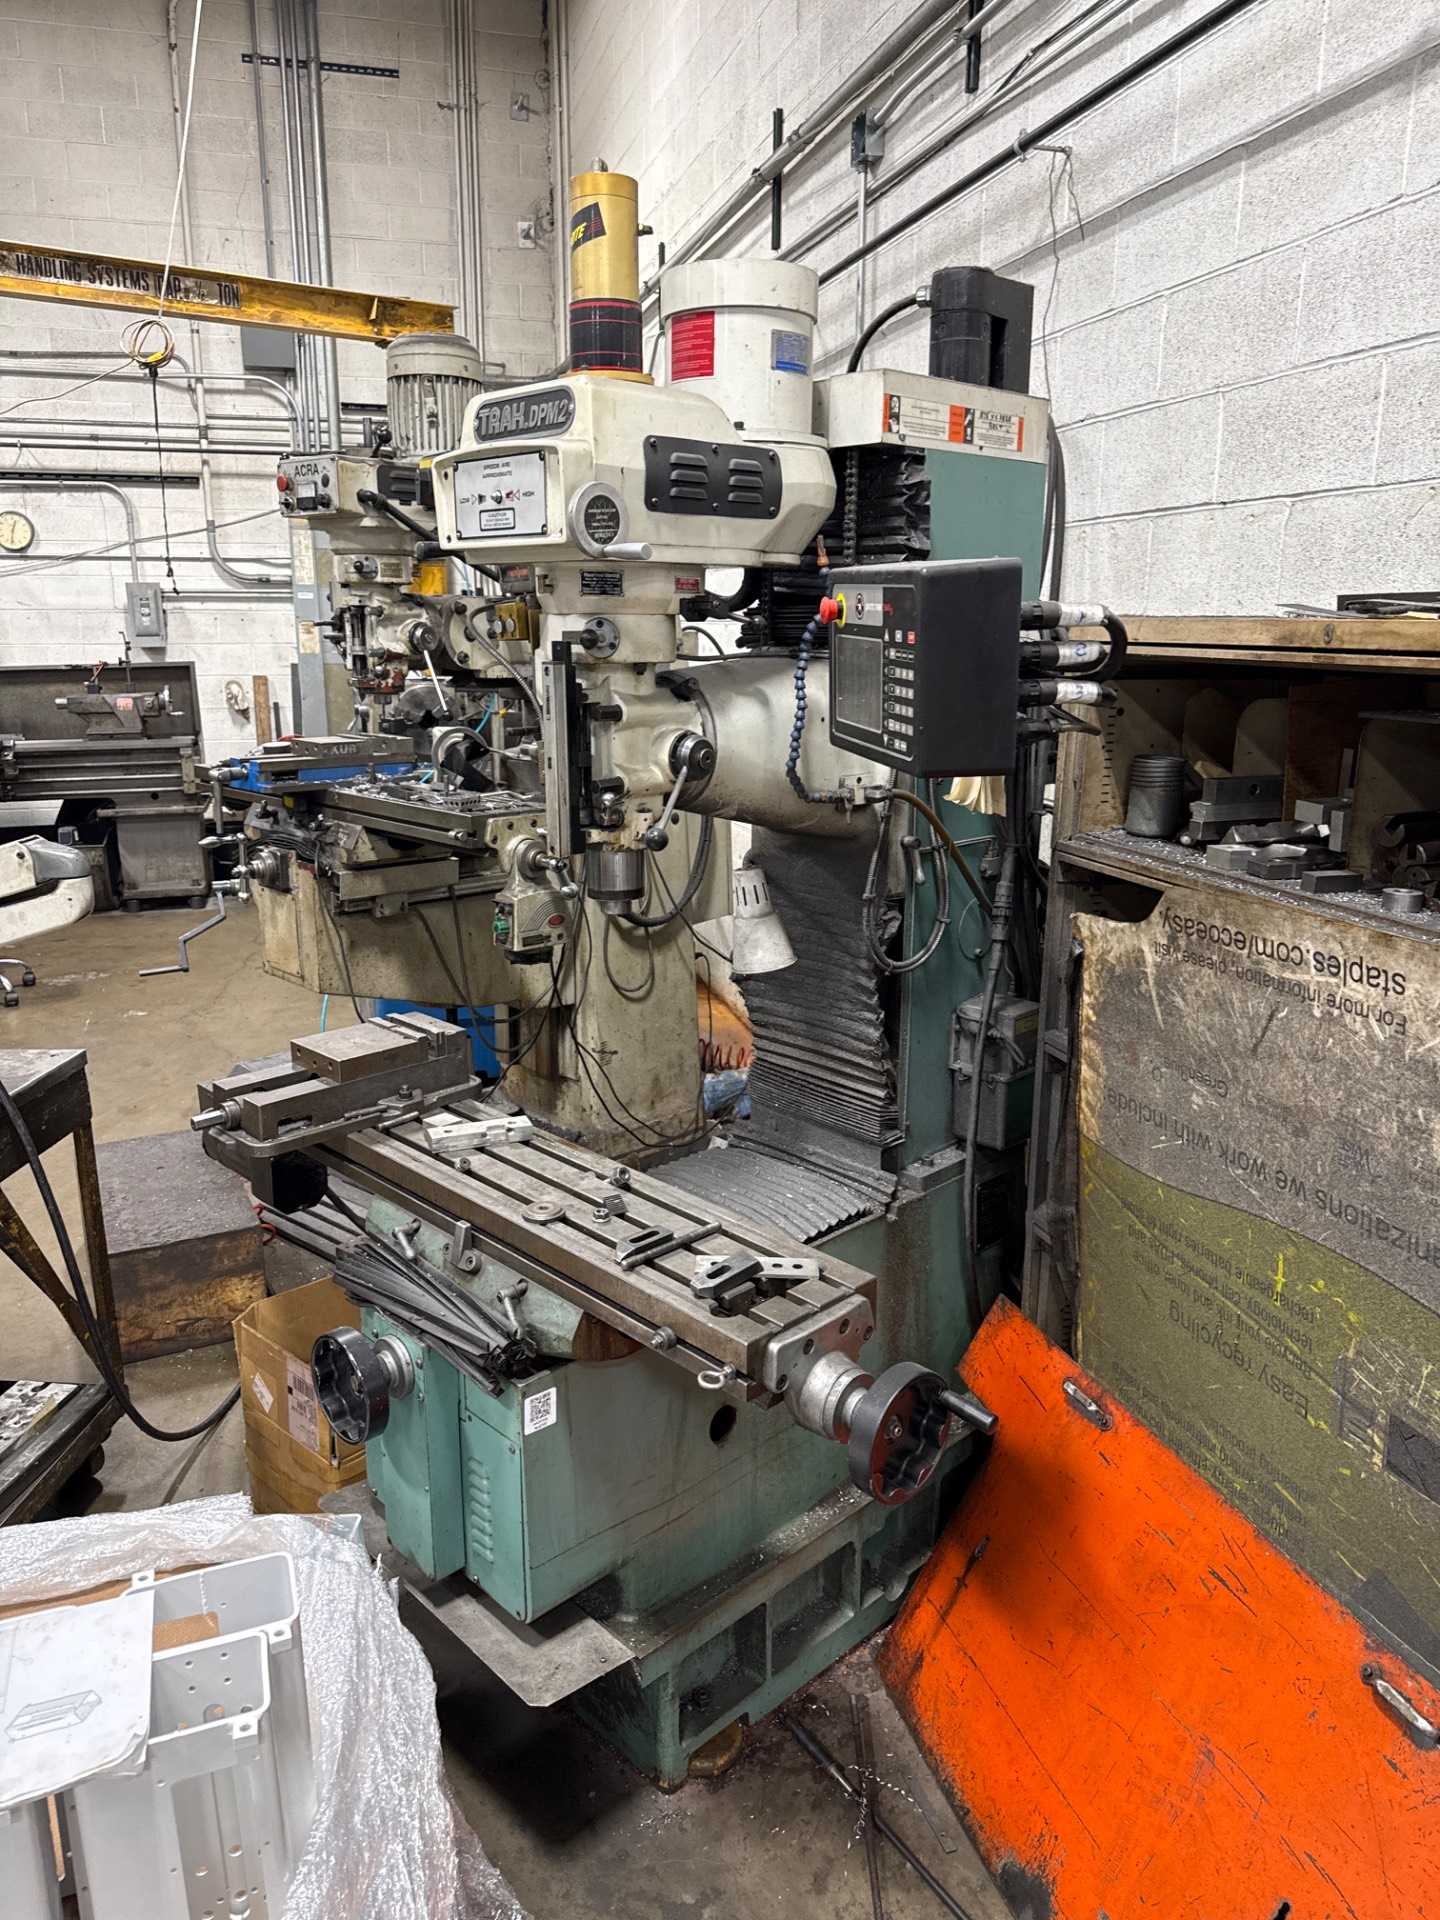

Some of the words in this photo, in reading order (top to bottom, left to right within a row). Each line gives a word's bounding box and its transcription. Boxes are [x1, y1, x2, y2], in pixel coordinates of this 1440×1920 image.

[15, 253, 83, 282] HANDLING
[87, 264, 150, 292] SYSTEMS
[216, 283, 240, 307] TON
[294, 463, 319, 477] ACRA
[1159, 906, 1407, 997] staples.com/ecoeasy.
[1182, 949, 1227, 978] please
[1326, 993, 1370, 1019] more
[1375, 1008, 1408, 1036] For
[1173, 1118, 1212, 1153] with
[1218, 1139, 1268, 1182] work
[1274, 1169, 1307, 1202] we
[1169, 1299, 1254, 1372] recycling
[1258, 1363, 1309, 1420] Easy
